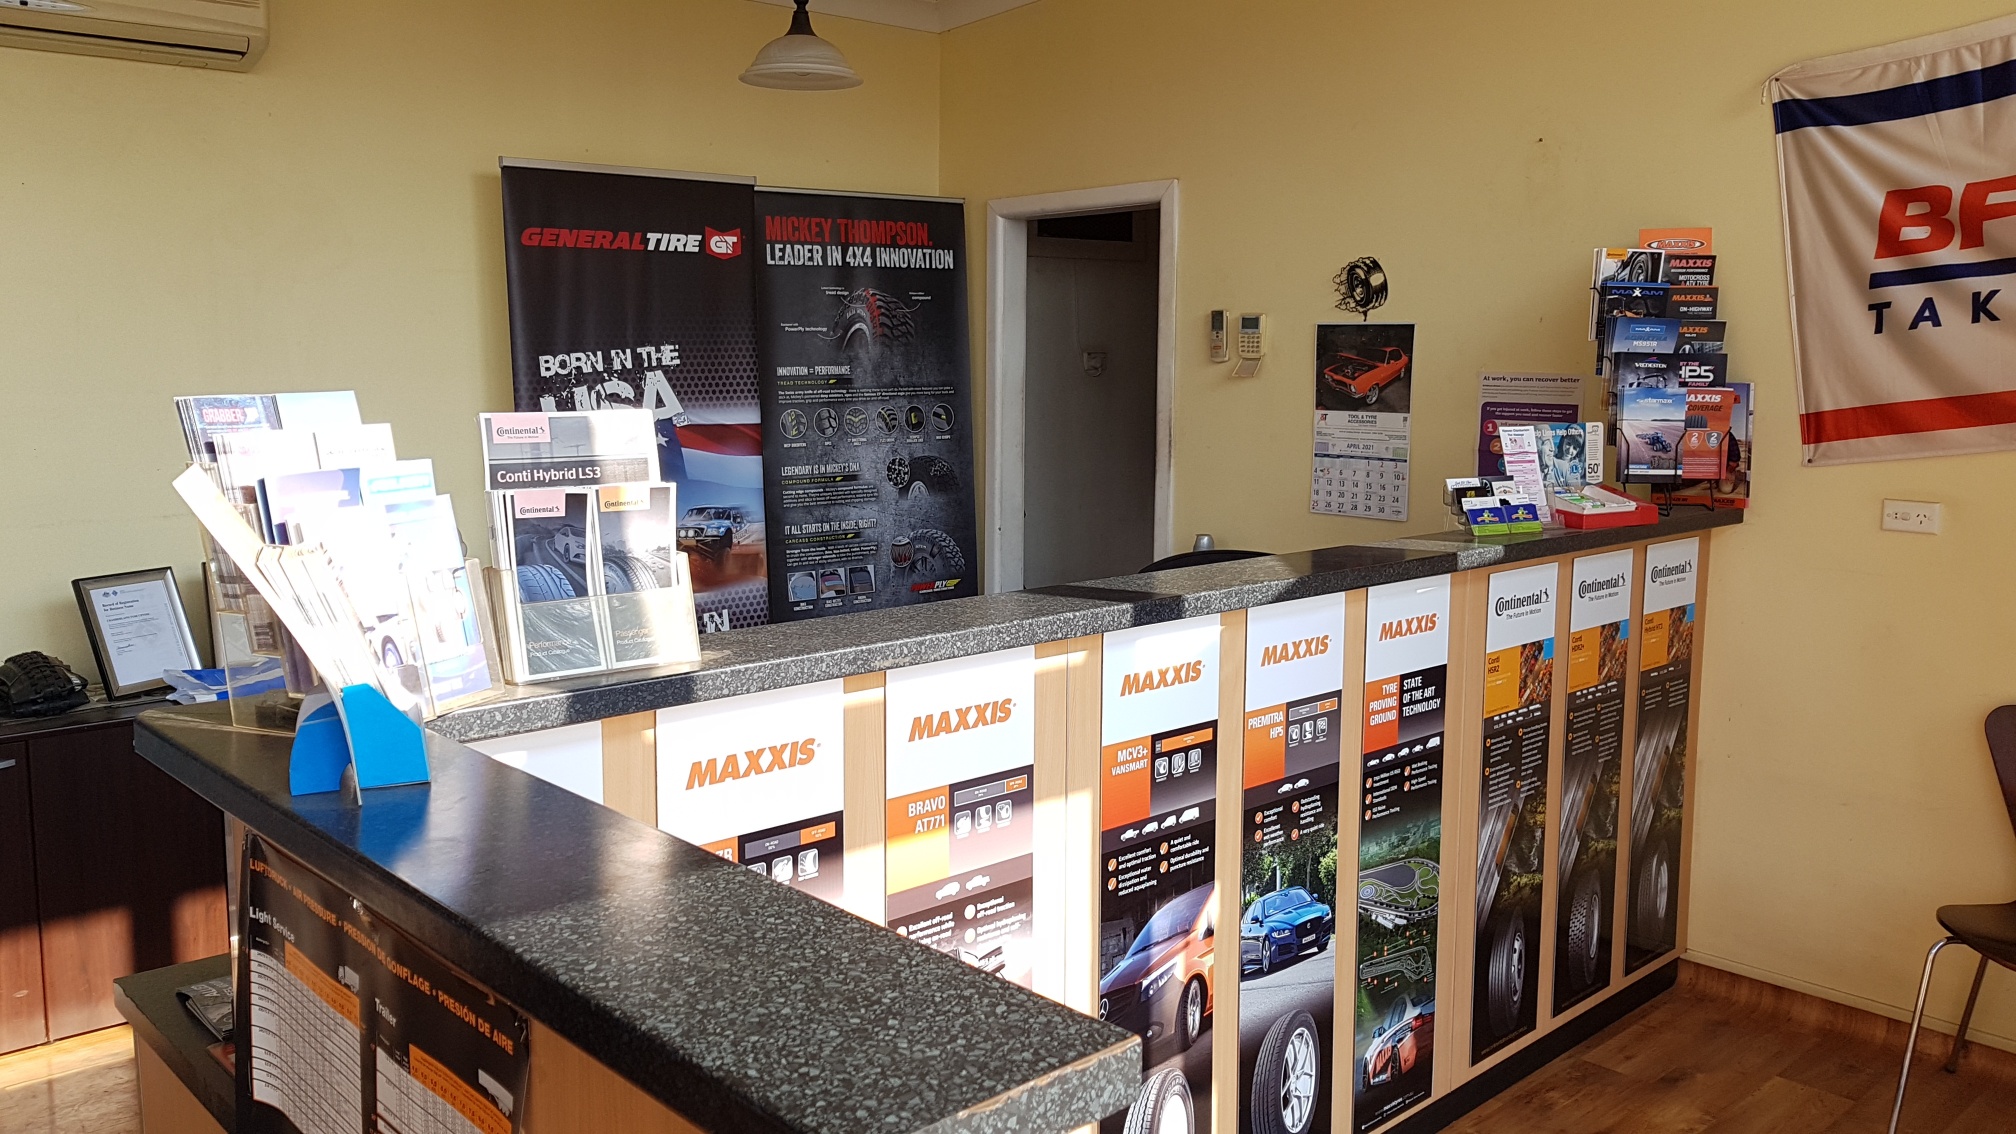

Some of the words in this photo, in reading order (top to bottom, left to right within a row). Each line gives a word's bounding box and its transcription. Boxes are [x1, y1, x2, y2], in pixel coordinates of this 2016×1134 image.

[765, 216, 832, 243] MICKEY
[837, 218, 933, 246] THOMPSON.
[766, 243, 823, 266] LEADER
[827, 246, 842, 266] IN
[845, 246, 873, 267] 4X4
[876, 248, 954, 269] INNOVATION
[1669, 259, 1712, 267] MAXXIS
[1612, 287, 1664, 297] MAXAM
[1867, 289, 2001, 335] TAK
[539, 350, 604, 377] BORN
[611, 348, 632, 370] IN
[637, 344, 681, 368] THE
[776, 366, 808, 376] INNOVATION
[814, 366, 851, 375] PERFORMANCE
[202, 408, 244, 423] GRABBER
[497, 426, 538, 437] Continental
[1556, 428, 1567, 436] Help
[1568, 428, 1583, 436] Others
[1692, 432, 1698, 440] 2
[1711, 432, 1717, 440] 2
[497, 470, 531, 483] Conti
[534, 468, 576, 483] Hybrid
[578, 466, 602, 479] LS3
[781, 465, 812, 476] LEGENDARY
[814, 465, 818, 474] IS
[820, 464, 825, 474] IN
[826, 463, 848, 473] MICKEY'S
[520, 506, 554, 516] Continental
[604, 500, 638, 509] Continental
[785, 525, 790, 535] IT
[791, 525, 802, 535] ALL
[802, 523, 822, 534] STARTS
[822, 522, 830, 532] ON
[831, 521, 840, 531] THE
[858, 518, 877, 528] RIGHT?
[1651, 560, 1686, 584] Continental
[1578, 574, 1620, 599] Continental
[1495, 589, 1542, 617] Continental
[1513, 611, 1525, 619] Future
[616, 628, 650, 638] Passenger
[1378, 612, 1438, 642] MAXXIS
[1260, 634, 1330, 667] MAXXIS
[1488, 656, 1500, 665] Conti
[1120, 660, 1203, 698] MAXXIS
[1403, 676, 1422, 690] STATE
[1382, 682, 1398, 696] TYRE
[1403, 692, 1412, 704] OF
[1412, 689, 1423, 701] THE
[1423, 686, 1436, 699] ART
[1369, 696, 1397, 712] PROVING
[1402, 698, 1441, 717] TECHNOLOGY
[908, 698, 1012, 742] MAXXIS
[1248, 711, 1284, 730] PREMITRA
[1370, 710, 1397, 726] GROUND
[1270, 725, 1284, 739] HP5
[1117, 745, 1148, 763] MCV3+
[685, 738, 816, 790] MAXXIS
[1111, 758, 1148, 776] VANSMART
[908, 796, 946, 817] BRAVO
[914, 814, 945, 834] AT771
[1118, 852, 1136, 862] Excellent
[1136, 847, 1151, 856] comfort
[1170, 842, 1192, 853] comfortable
[1142, 854, 1156, 862] traction
[1170, 853, 1184, 864] Optimal
[1185, 849, 1202, 859] durability
[1170, 862, 1186, 872] puncture
[1187, 856, 1204, 866] resistance
[1118, 870, 1140, 880] Exceptional
[1118, 887, 1133, 896] reduced
[1134, 879, 1157, 892] aquaplaning
[250, 906, 272, 926] Light
[272, 917, 295, 944] Service
[292, 886, 303, 902] AIR
[304, 893, 337, 927] PRESSURE
[343, 921, 377, 956] PRESSION
[377, 947, 386, 965] DE
[386, 956, 431, 996] GONFLAGE
[438, 989, 476, 1028] PRESIÓN
[478, 1018, 491, 1038] DE
[492, 1029, 514, 1056] AIRE
[375, 997, 396, 1028] Trailer
